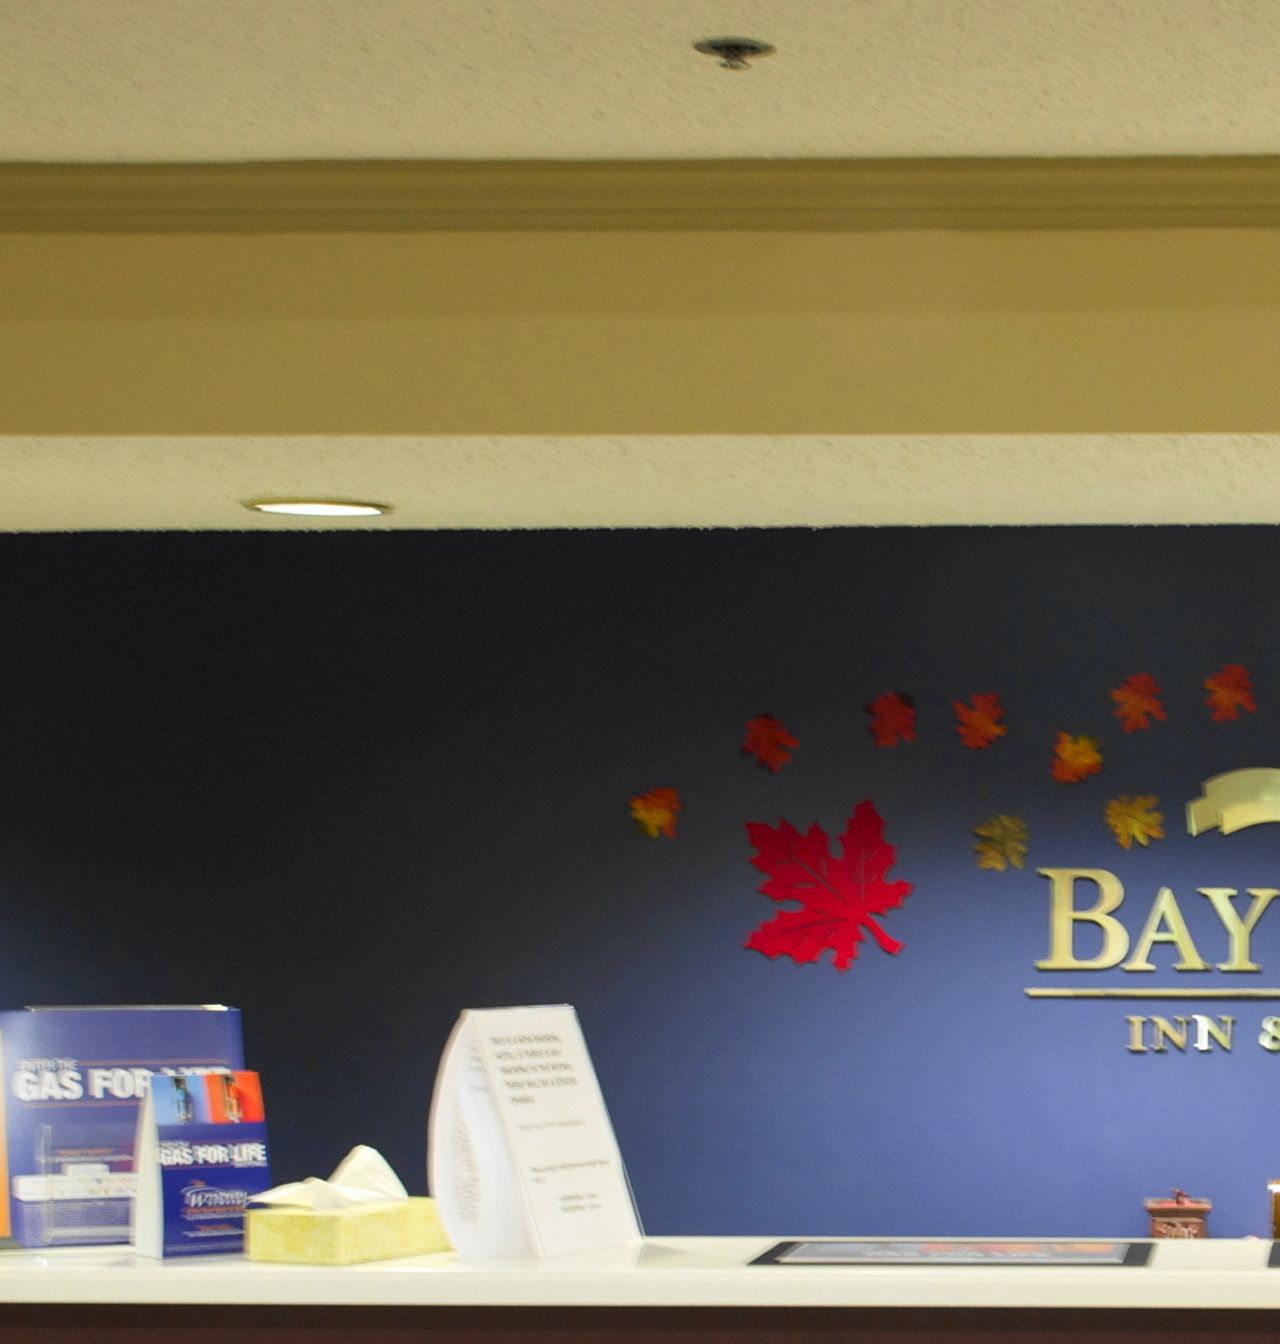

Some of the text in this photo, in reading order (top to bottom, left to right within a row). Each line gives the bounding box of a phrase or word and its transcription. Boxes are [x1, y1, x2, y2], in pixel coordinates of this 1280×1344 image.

[1125, 1015, 1237, 1054] INN
[13, 1070, 84, 1101] GAS
[157, 1144, 193, 1166] GAS
[193, 1143, 229, 1164] FOR
[229, 1142, 267, 1164] LIFE
